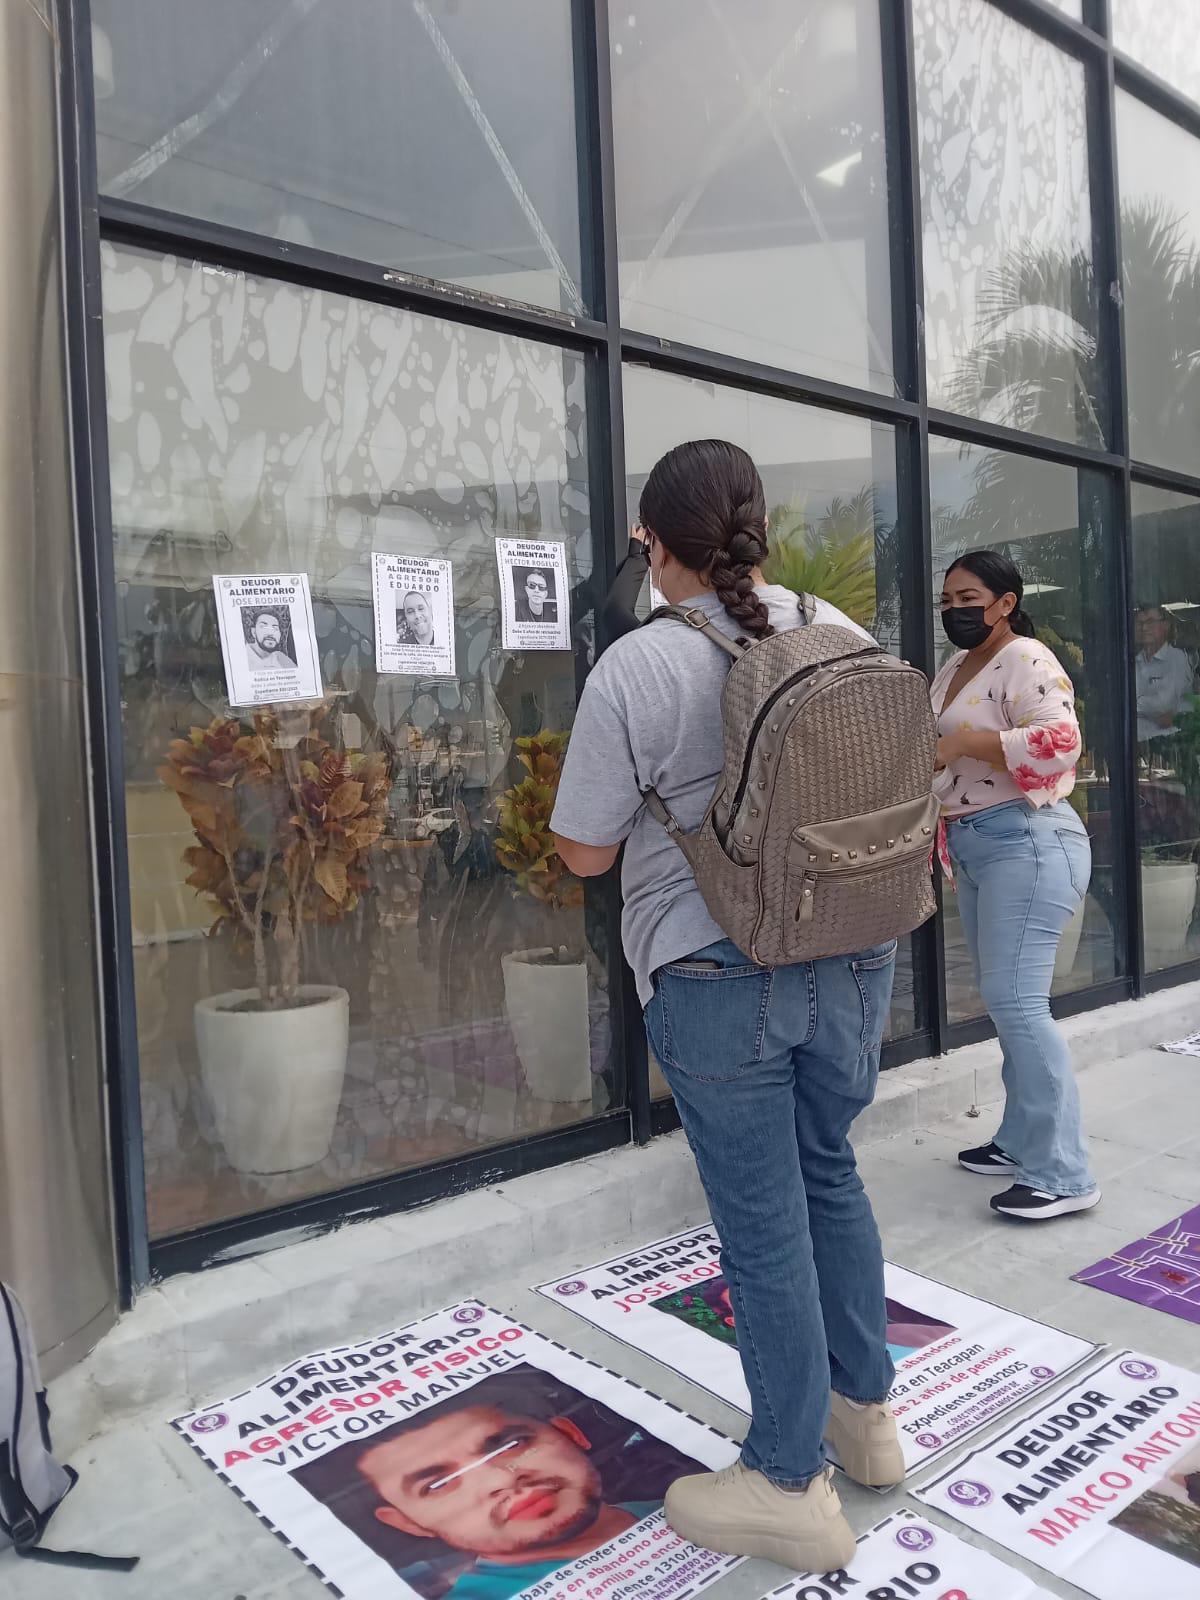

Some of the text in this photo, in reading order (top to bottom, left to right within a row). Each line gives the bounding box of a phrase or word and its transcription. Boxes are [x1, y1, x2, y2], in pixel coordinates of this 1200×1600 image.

[397, 558, 429, 567] DEUDOR
[505, 558, 560, 568] HECTOR ROGELIO
[507, 550, 555, 560] ALIMENTARIO
[517, 543, 546, 551] DEUDOR
[229, 587, 296, 596] ALIMENTARIO
[241, 578, 281, 587] DEUDOR
[387, 565, 440, 576] ALIMENTARIO
[388, 573, 439, 584] AGRESOR
[389, 581, 439, 592] EDUARDO
[232, 596, 295, 608] JOSE RODRIGO
[590, 1244, 722, 1301] ALIMENTA
[606, 1233, 717, 1276] DEUDOR
[613, 1281, 677, 1313] JOSE
[270, 1333, 420, 1398] DEUDOR
[901, 1337, 962, 1369] abandono
[909, 1374, 929, 1387] en
[923, 1343, 985, 1376] Teacapan
[223, 1327, 523, 1468] AGRESOR FISICO
[238, 1327, 482, 1439] ALIMENTARIO
[901, 1360, 1029, 1435] Expediente 838/2025
[906, 1398, 921, 1406] 2
[919, 1381, 952, 1400] años
[950, 1371, 969, 1384] de
[966, 1347, 1016, 1376] pensión
[262, 1348, 526, 1467] VICTOR MANUEL
[941, 1418, 976, 1440] DEUDORES
[973, 1395, 1015, 1421] ALIMENTARIOS
[946, 1380, 1021, 1426] COLECTIVO TENDEDERO DE
[996, 1390, 1116, 1469] DEUDOR
[1001, 1386, 1179, 1516] ALIMENTARIO
[1026, 1471, 1133, 1548] MARCO
[554, 1569, 574, 1581] de
[574, 1543, 617, 1570] chofer
[618, 1532, 637, 1545] en
[566, 1578, 586, 1592] en
[586, 1540, 651, 1579] abandono
[653, 1558, 701, 1590] TENDEDERO
[585, 1568, 636, 1600] familia
[633, 1560, 650, 1569] lo
